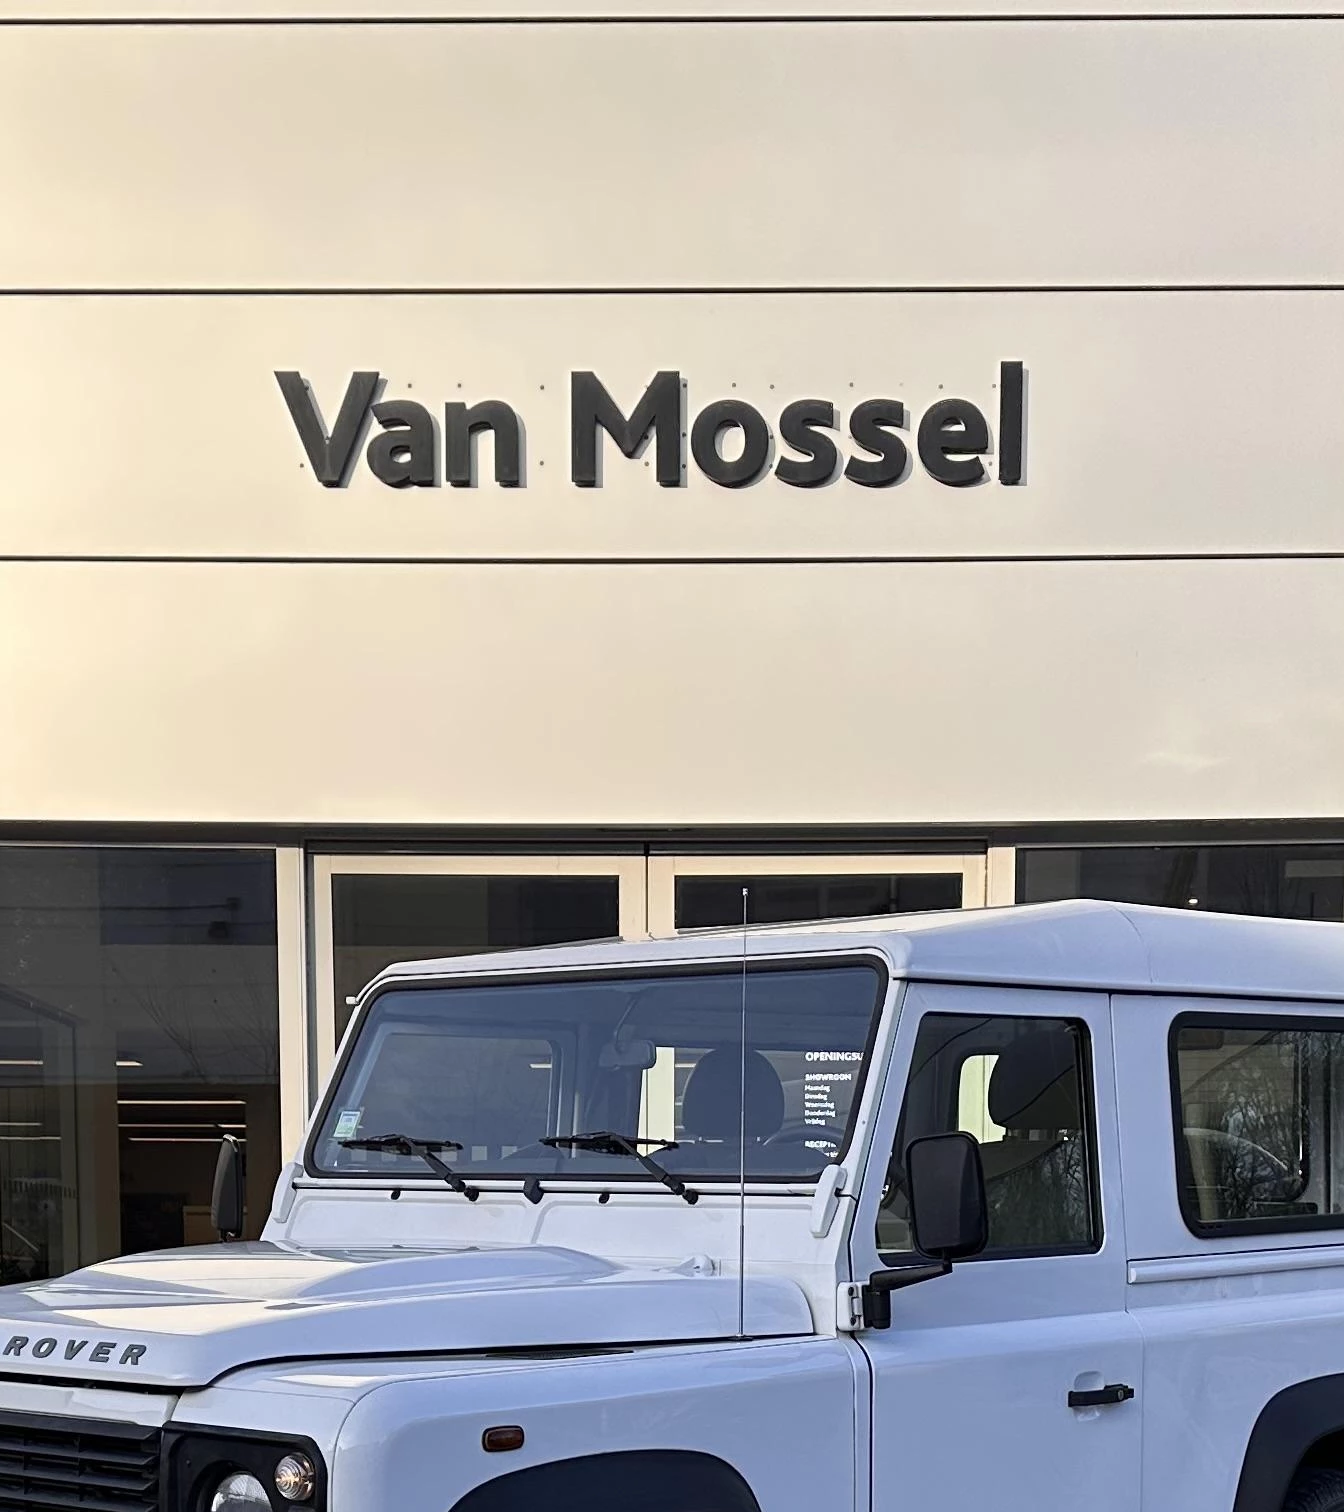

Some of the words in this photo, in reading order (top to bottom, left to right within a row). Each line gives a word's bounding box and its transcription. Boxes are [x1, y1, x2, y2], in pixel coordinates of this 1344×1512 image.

[273, 369, 524, 488] Van
[570, 359, 1026, 488] Mossel
[2, 1335, 148, 1366] ROVER
